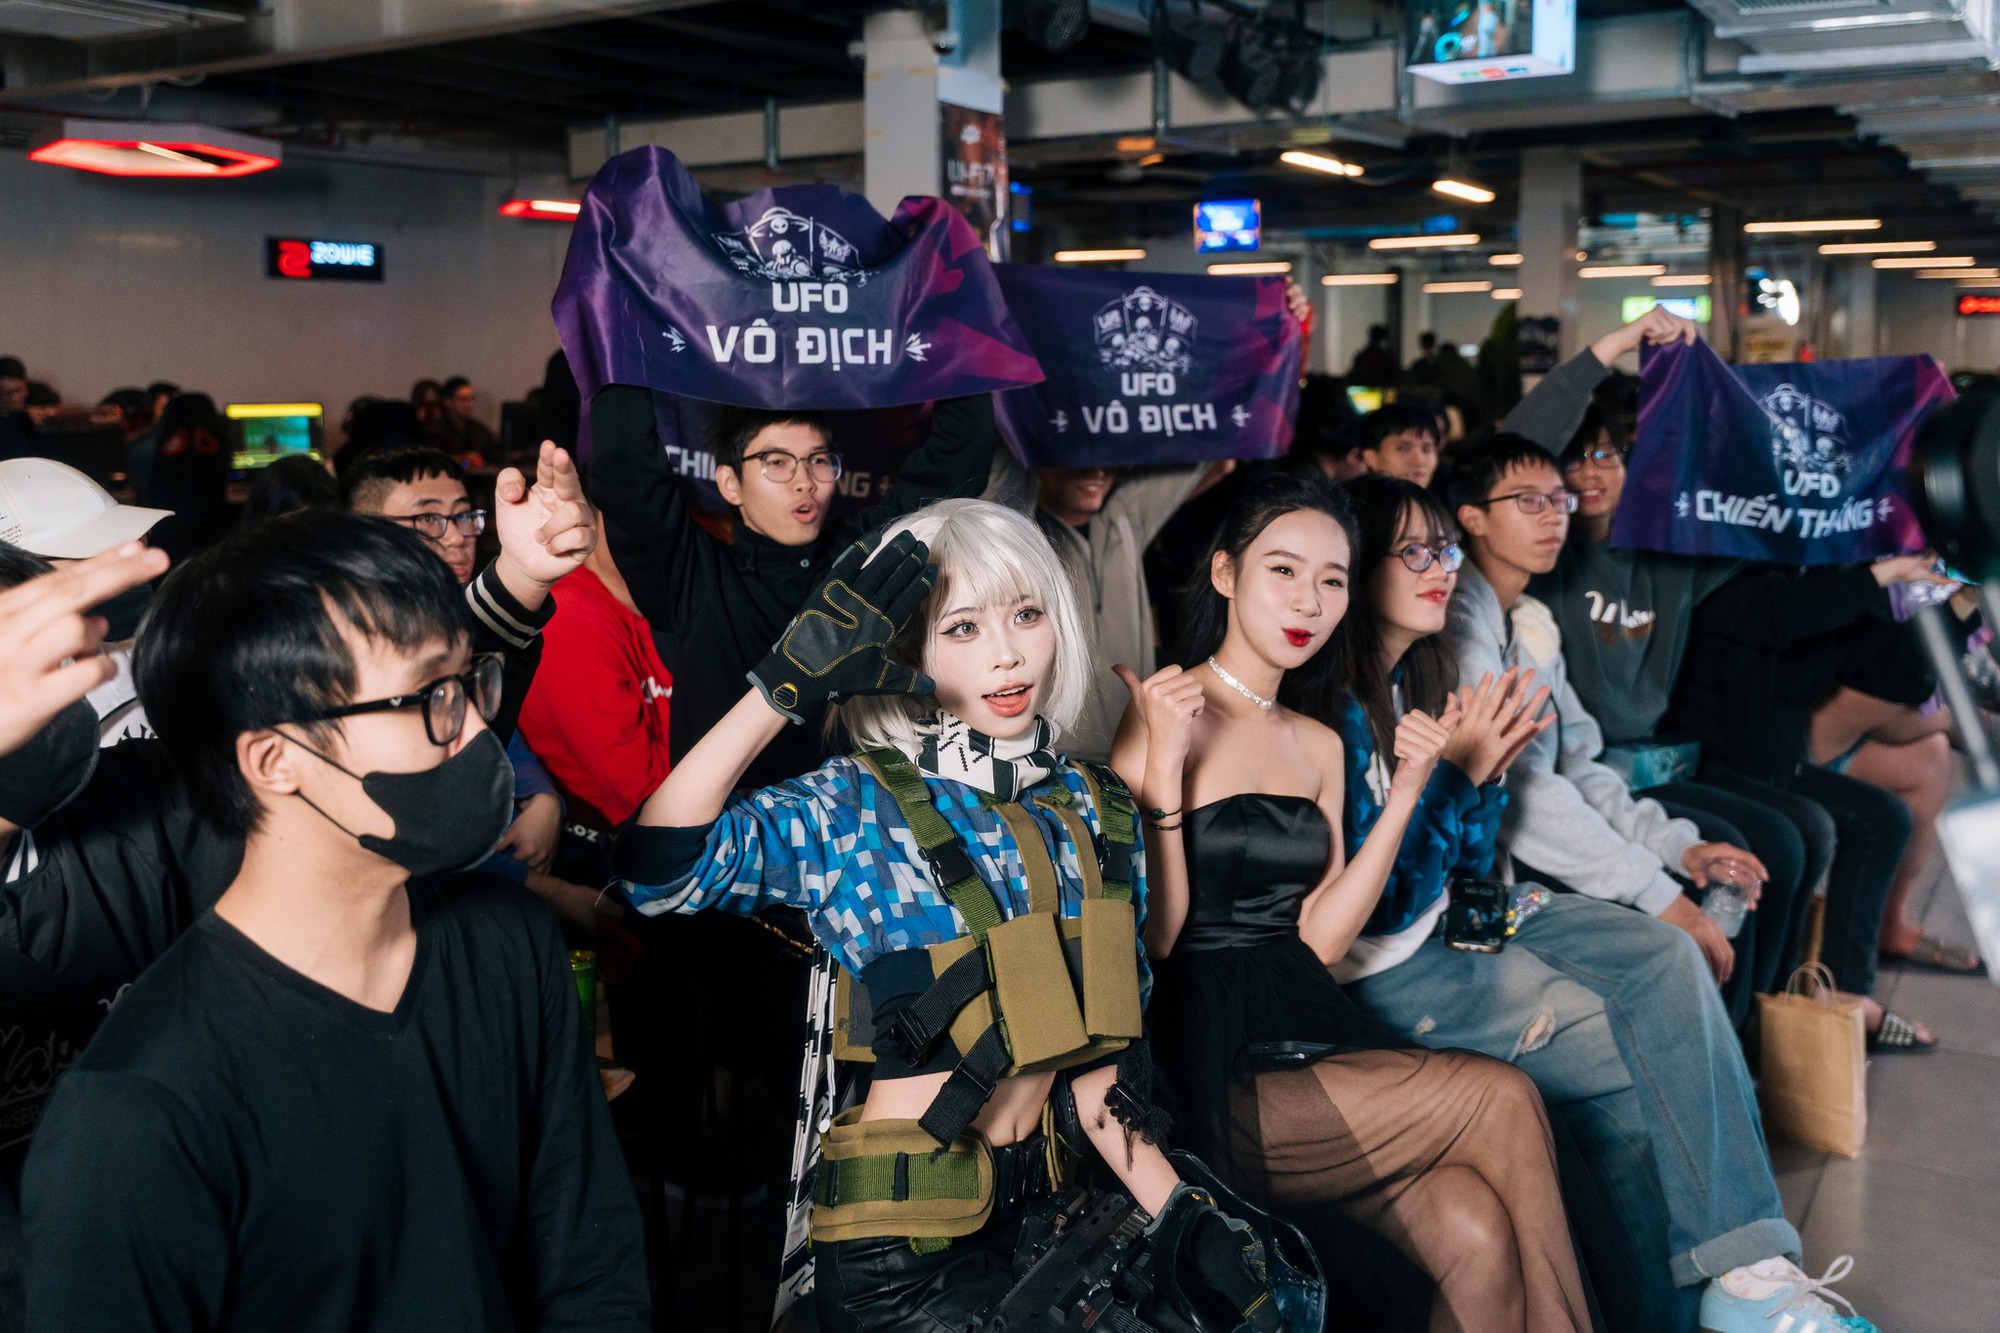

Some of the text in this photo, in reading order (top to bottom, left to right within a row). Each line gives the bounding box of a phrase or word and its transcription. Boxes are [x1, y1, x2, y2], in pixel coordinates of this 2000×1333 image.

[772, 282, 849, 314] UFO
[705, 317, 894, 372] VÔ ĐỊCH
[1120, 372, 1177, 397] UFO
[1081, 400, 1218, 438] VÔ ĐỊCH
[1695, 489, 1795, 534] CHIẾN
